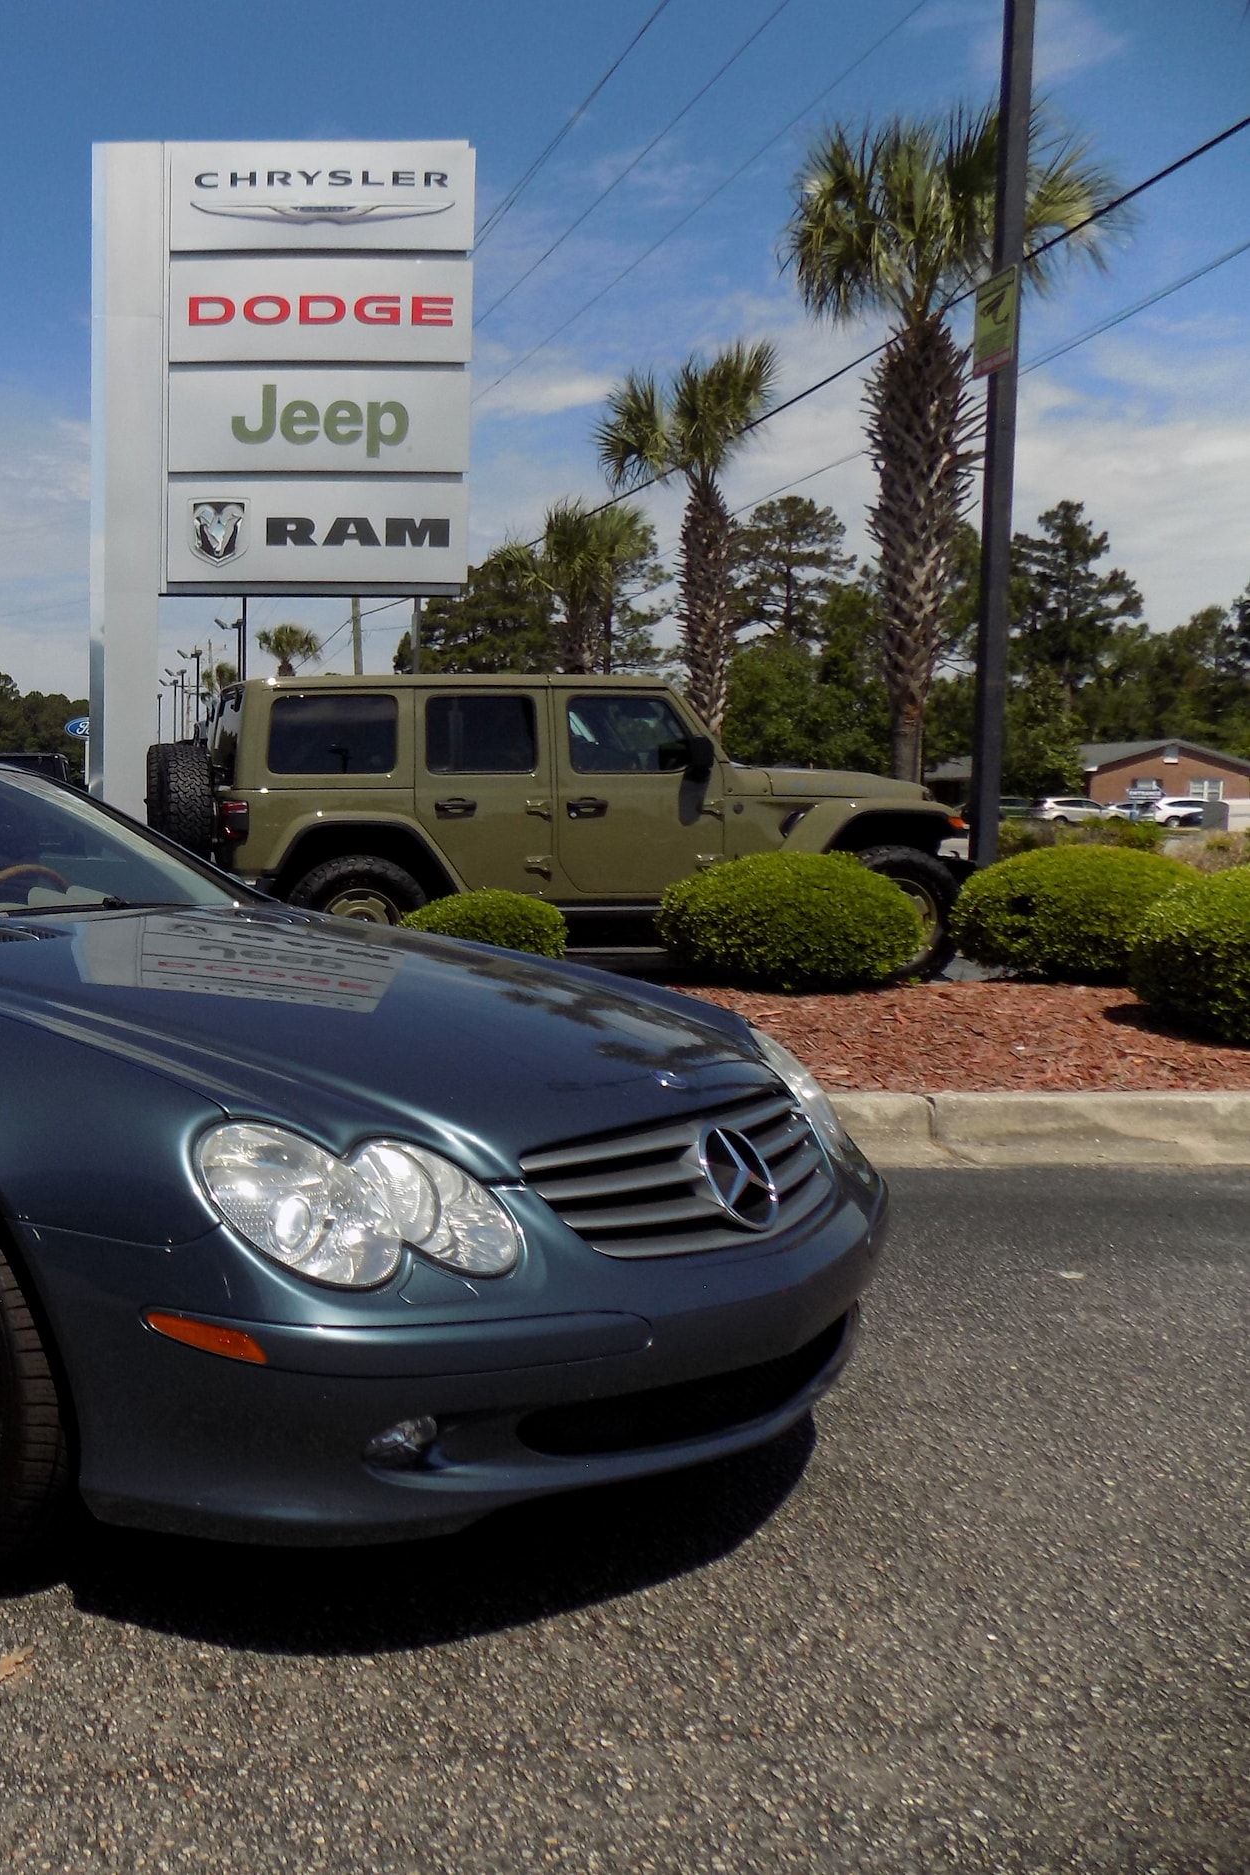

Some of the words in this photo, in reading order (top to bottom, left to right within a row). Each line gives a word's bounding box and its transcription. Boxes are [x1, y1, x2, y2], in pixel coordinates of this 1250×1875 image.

[193, 170, 449, 189] CHRYSLER
[188, 295, 454, 326] DODGE
[231, 384, 409, 458] Jeep
[265, 517, 450, 547] RAM
